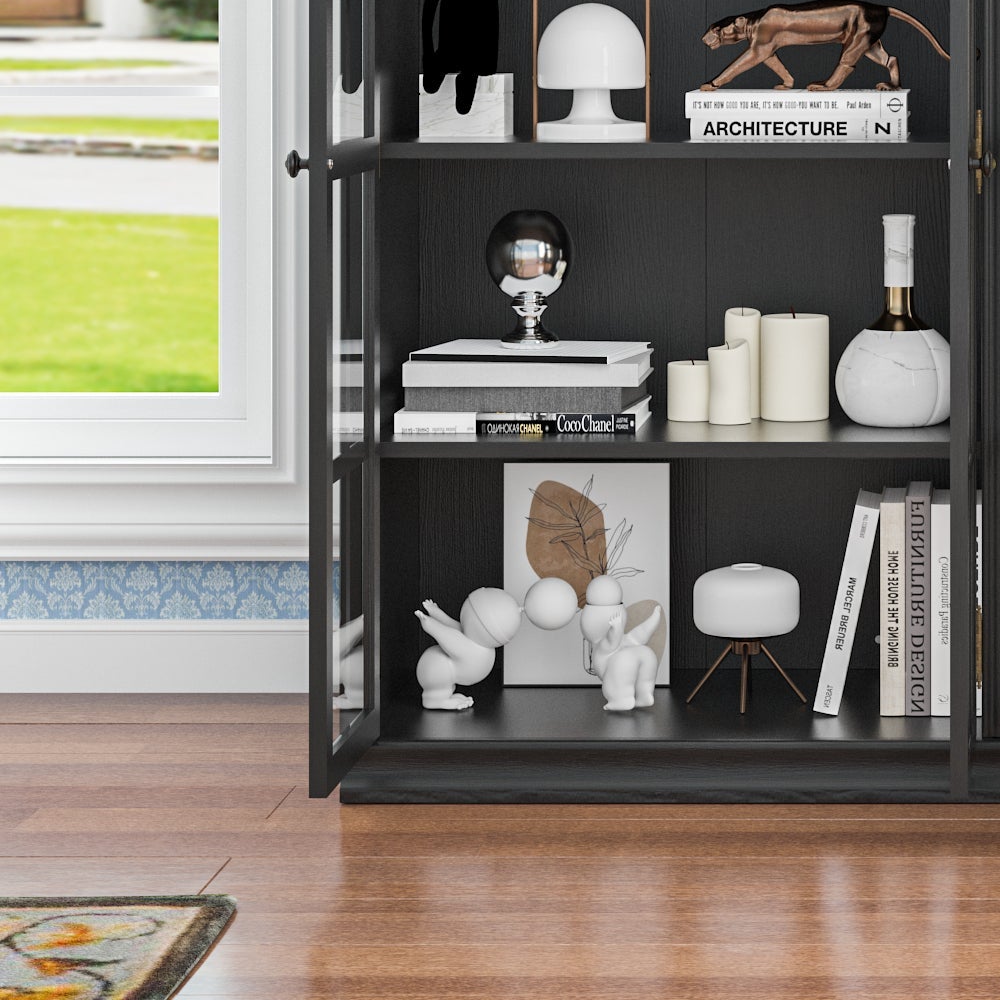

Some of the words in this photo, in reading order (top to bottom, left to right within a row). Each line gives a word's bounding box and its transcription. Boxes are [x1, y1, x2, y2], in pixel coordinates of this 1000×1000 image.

[703, 122, 847, 136] ARCHITECTURE
[520, 423, 543, 433] CHANEL
[557, 414, 581, 432] Coco
[581, 414, 614, 432] Chanel
